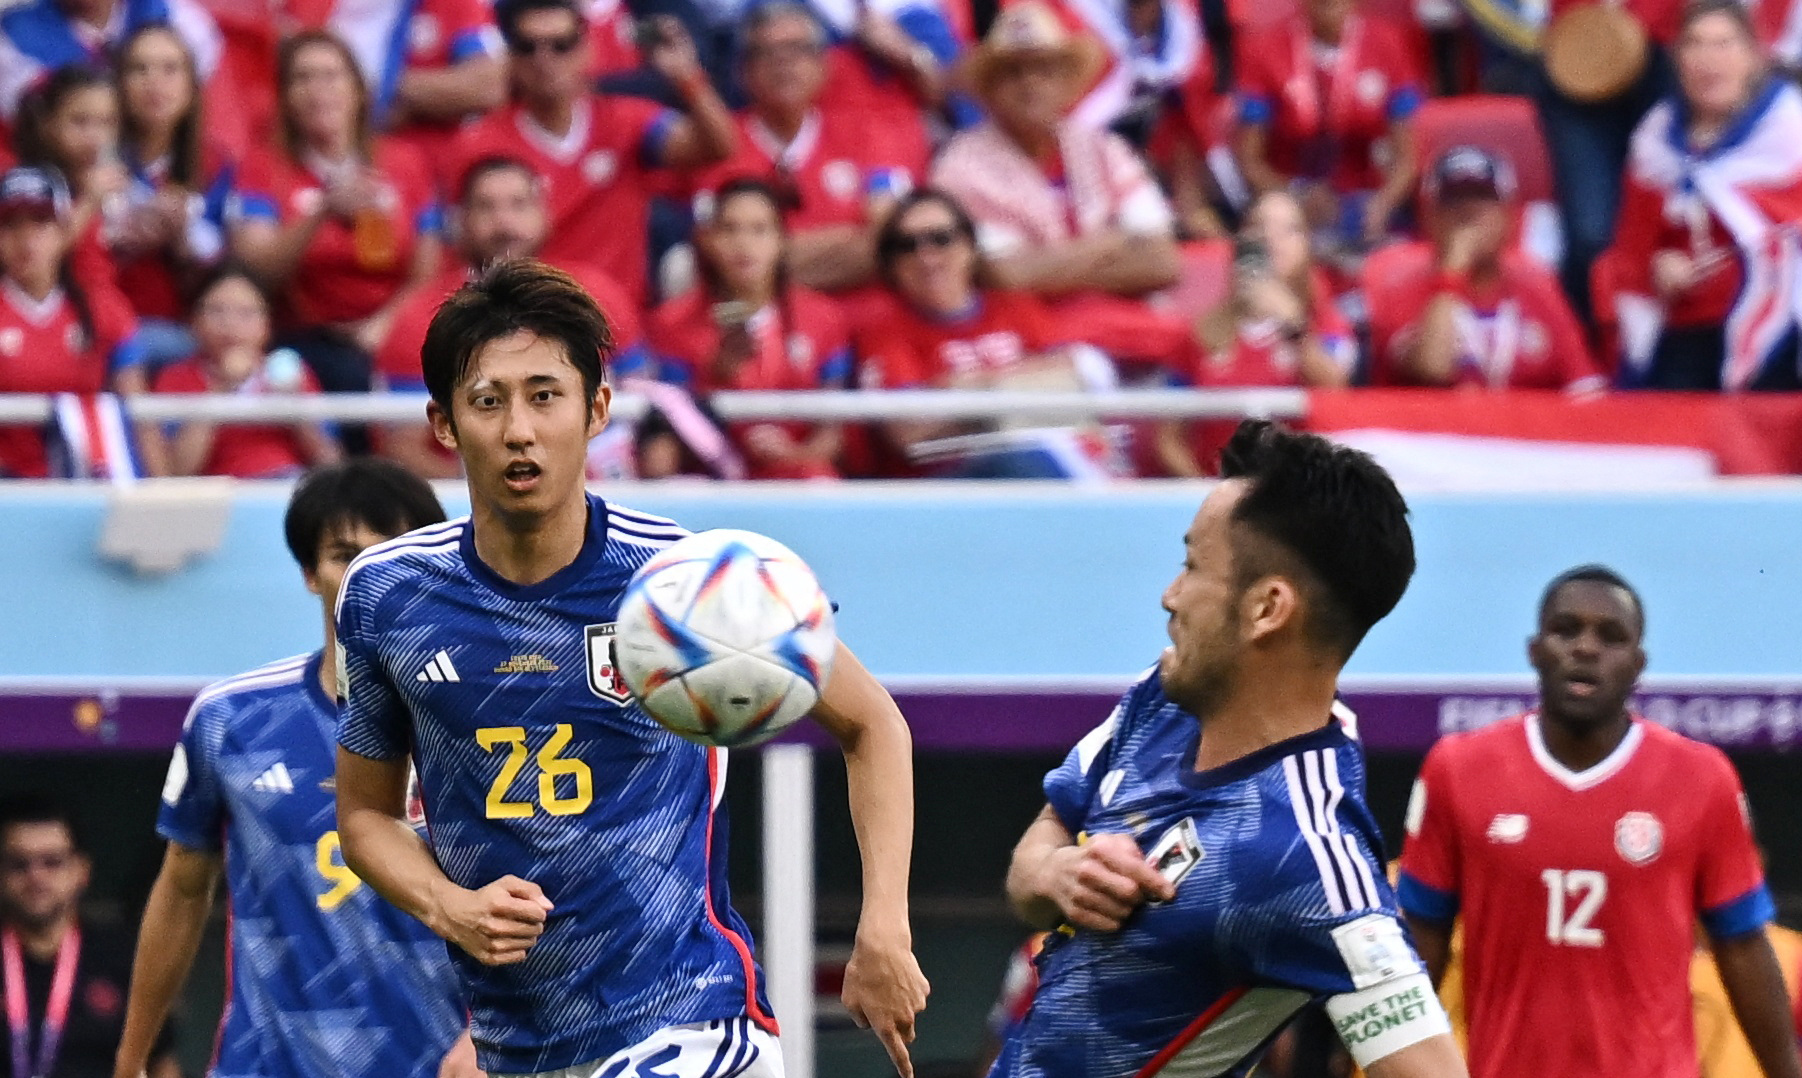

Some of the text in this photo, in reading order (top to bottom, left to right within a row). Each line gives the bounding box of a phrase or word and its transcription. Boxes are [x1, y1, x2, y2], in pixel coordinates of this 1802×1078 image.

[475, 723, 593, 819] 26
[1541, 868, 1608, 947] 12
[1382, 986, 1423, 1009] THE
